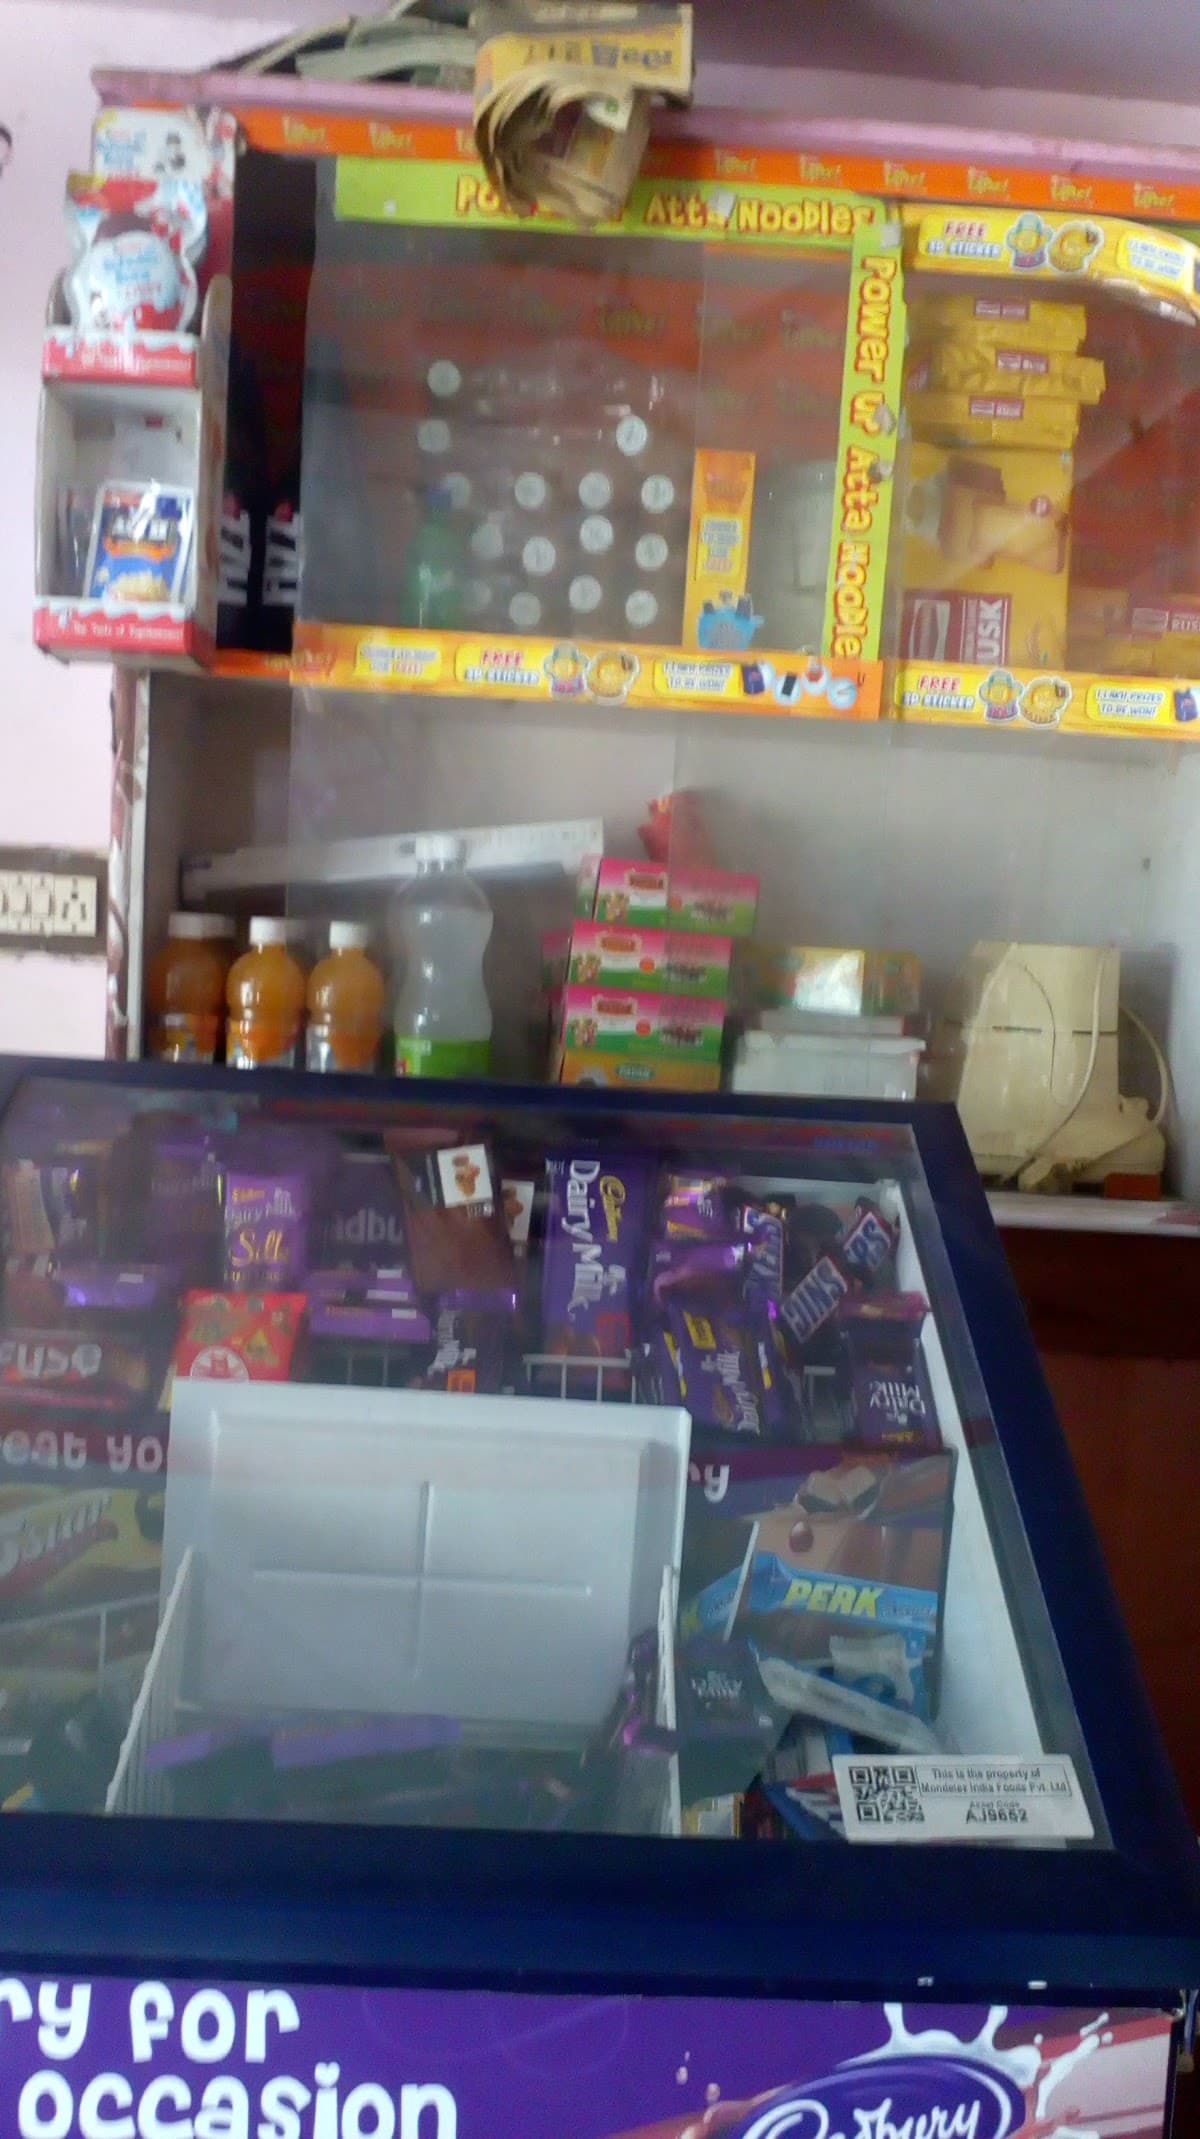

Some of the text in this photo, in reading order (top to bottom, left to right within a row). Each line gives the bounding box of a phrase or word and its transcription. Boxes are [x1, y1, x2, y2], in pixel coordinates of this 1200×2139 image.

[944, 222, 986, 238] FREE
[918, 675, 960, 691] FREE
[561, 1159, 604, 1322] Dairy Milk
[783, 1578, 884, 1619] PERK
[932, 1767, 1041, 1781] This is the property of
[970, 1783, 994, 1793] India
[996, 1783, 1026, 1793] Foods
[129, 1980, 300, 2063] for
[18, 2062, 457, 2139] occasion
